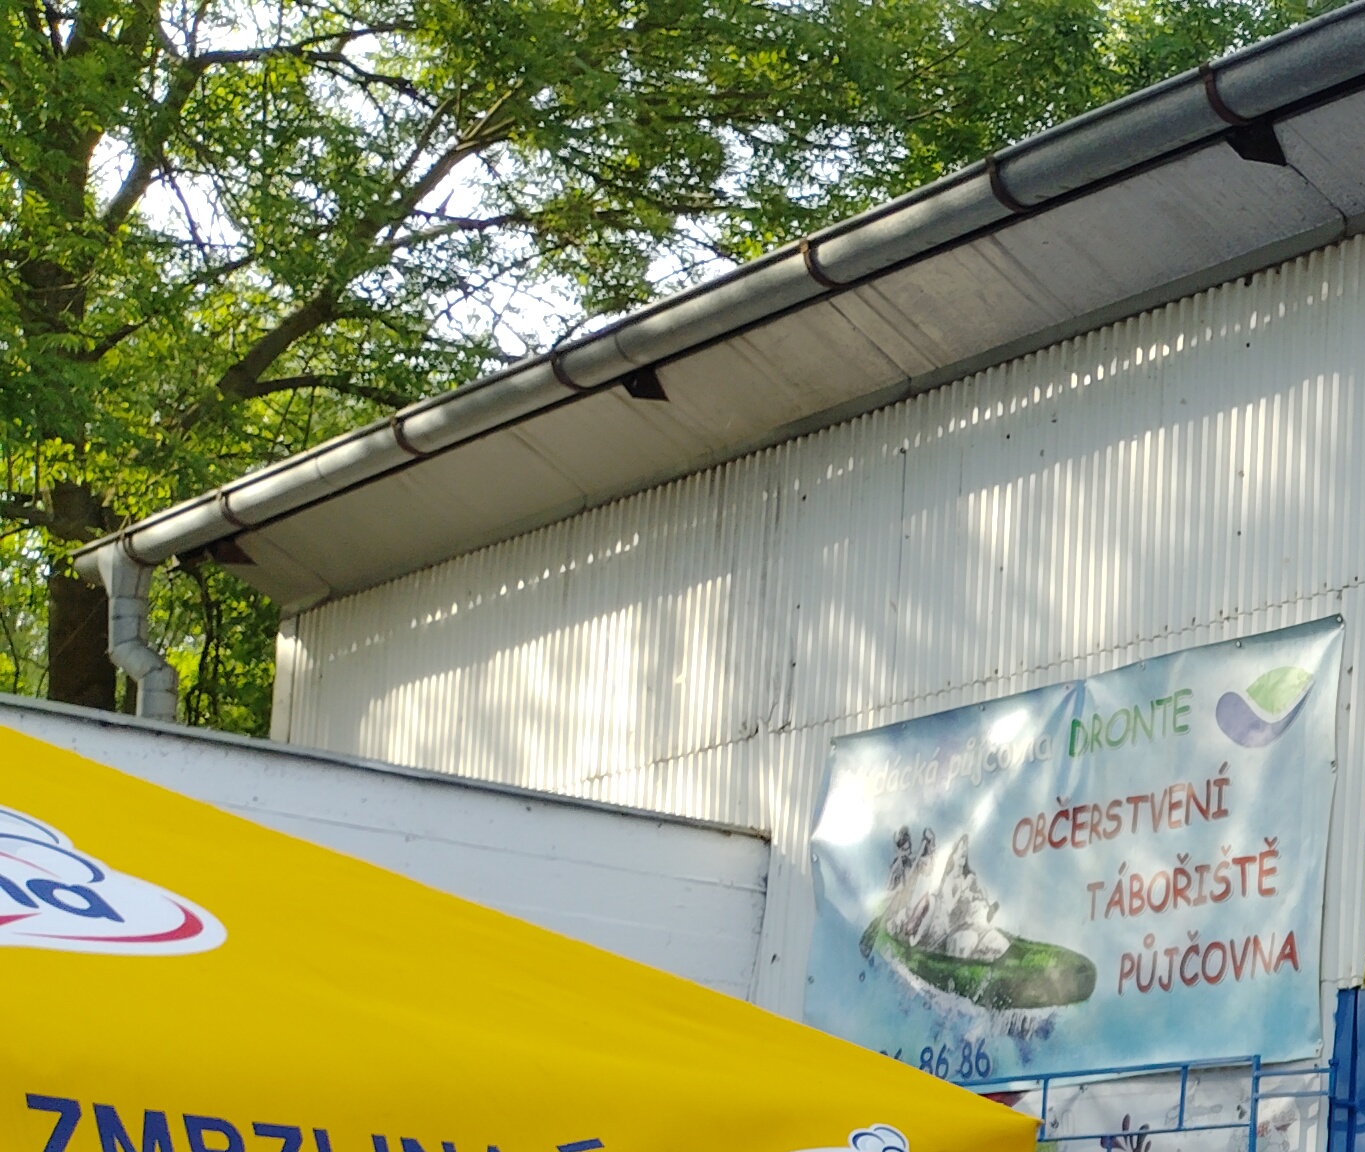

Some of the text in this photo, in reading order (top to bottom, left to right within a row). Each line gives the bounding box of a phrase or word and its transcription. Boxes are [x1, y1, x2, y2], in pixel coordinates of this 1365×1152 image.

[1067, 688, 1193, 758] DRONTE
[1012, 762, 1231, 857] OBČERSTVENÍ
[1086, 837, 1282, 922] TÁBOŘIŠTĚ
[1118, 930, 1300, 995] PŮJČOVNA
[960, 1039, 991, 1078] 86
